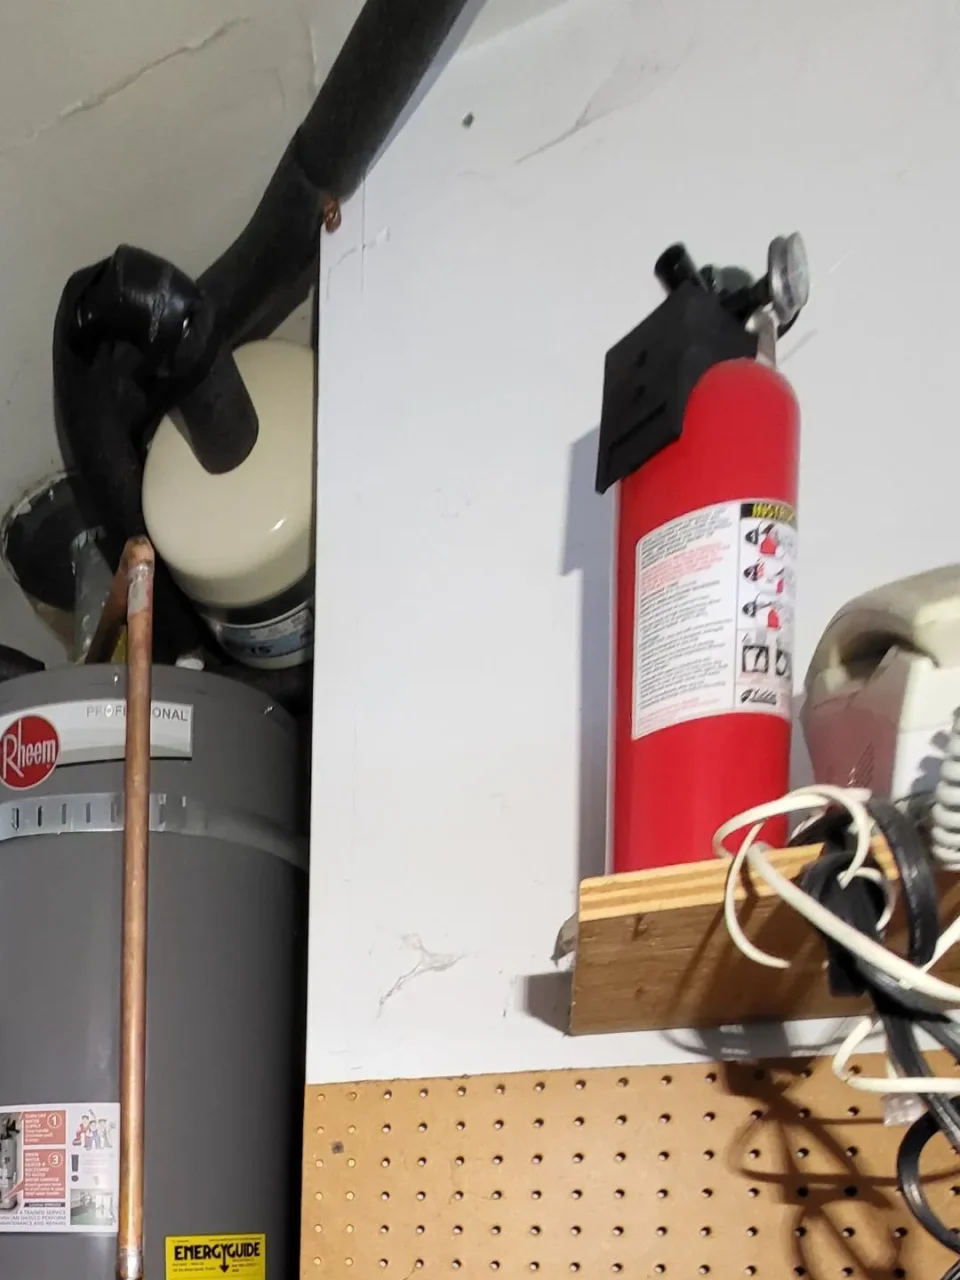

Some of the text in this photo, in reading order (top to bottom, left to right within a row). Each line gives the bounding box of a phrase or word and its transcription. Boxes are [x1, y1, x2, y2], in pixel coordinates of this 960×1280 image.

[86, 704, 188, 722] PROFONAL
[2, 719, 56, 779] Rheem
[174, 1242, 260, 1261] ENERGYGUIDE
